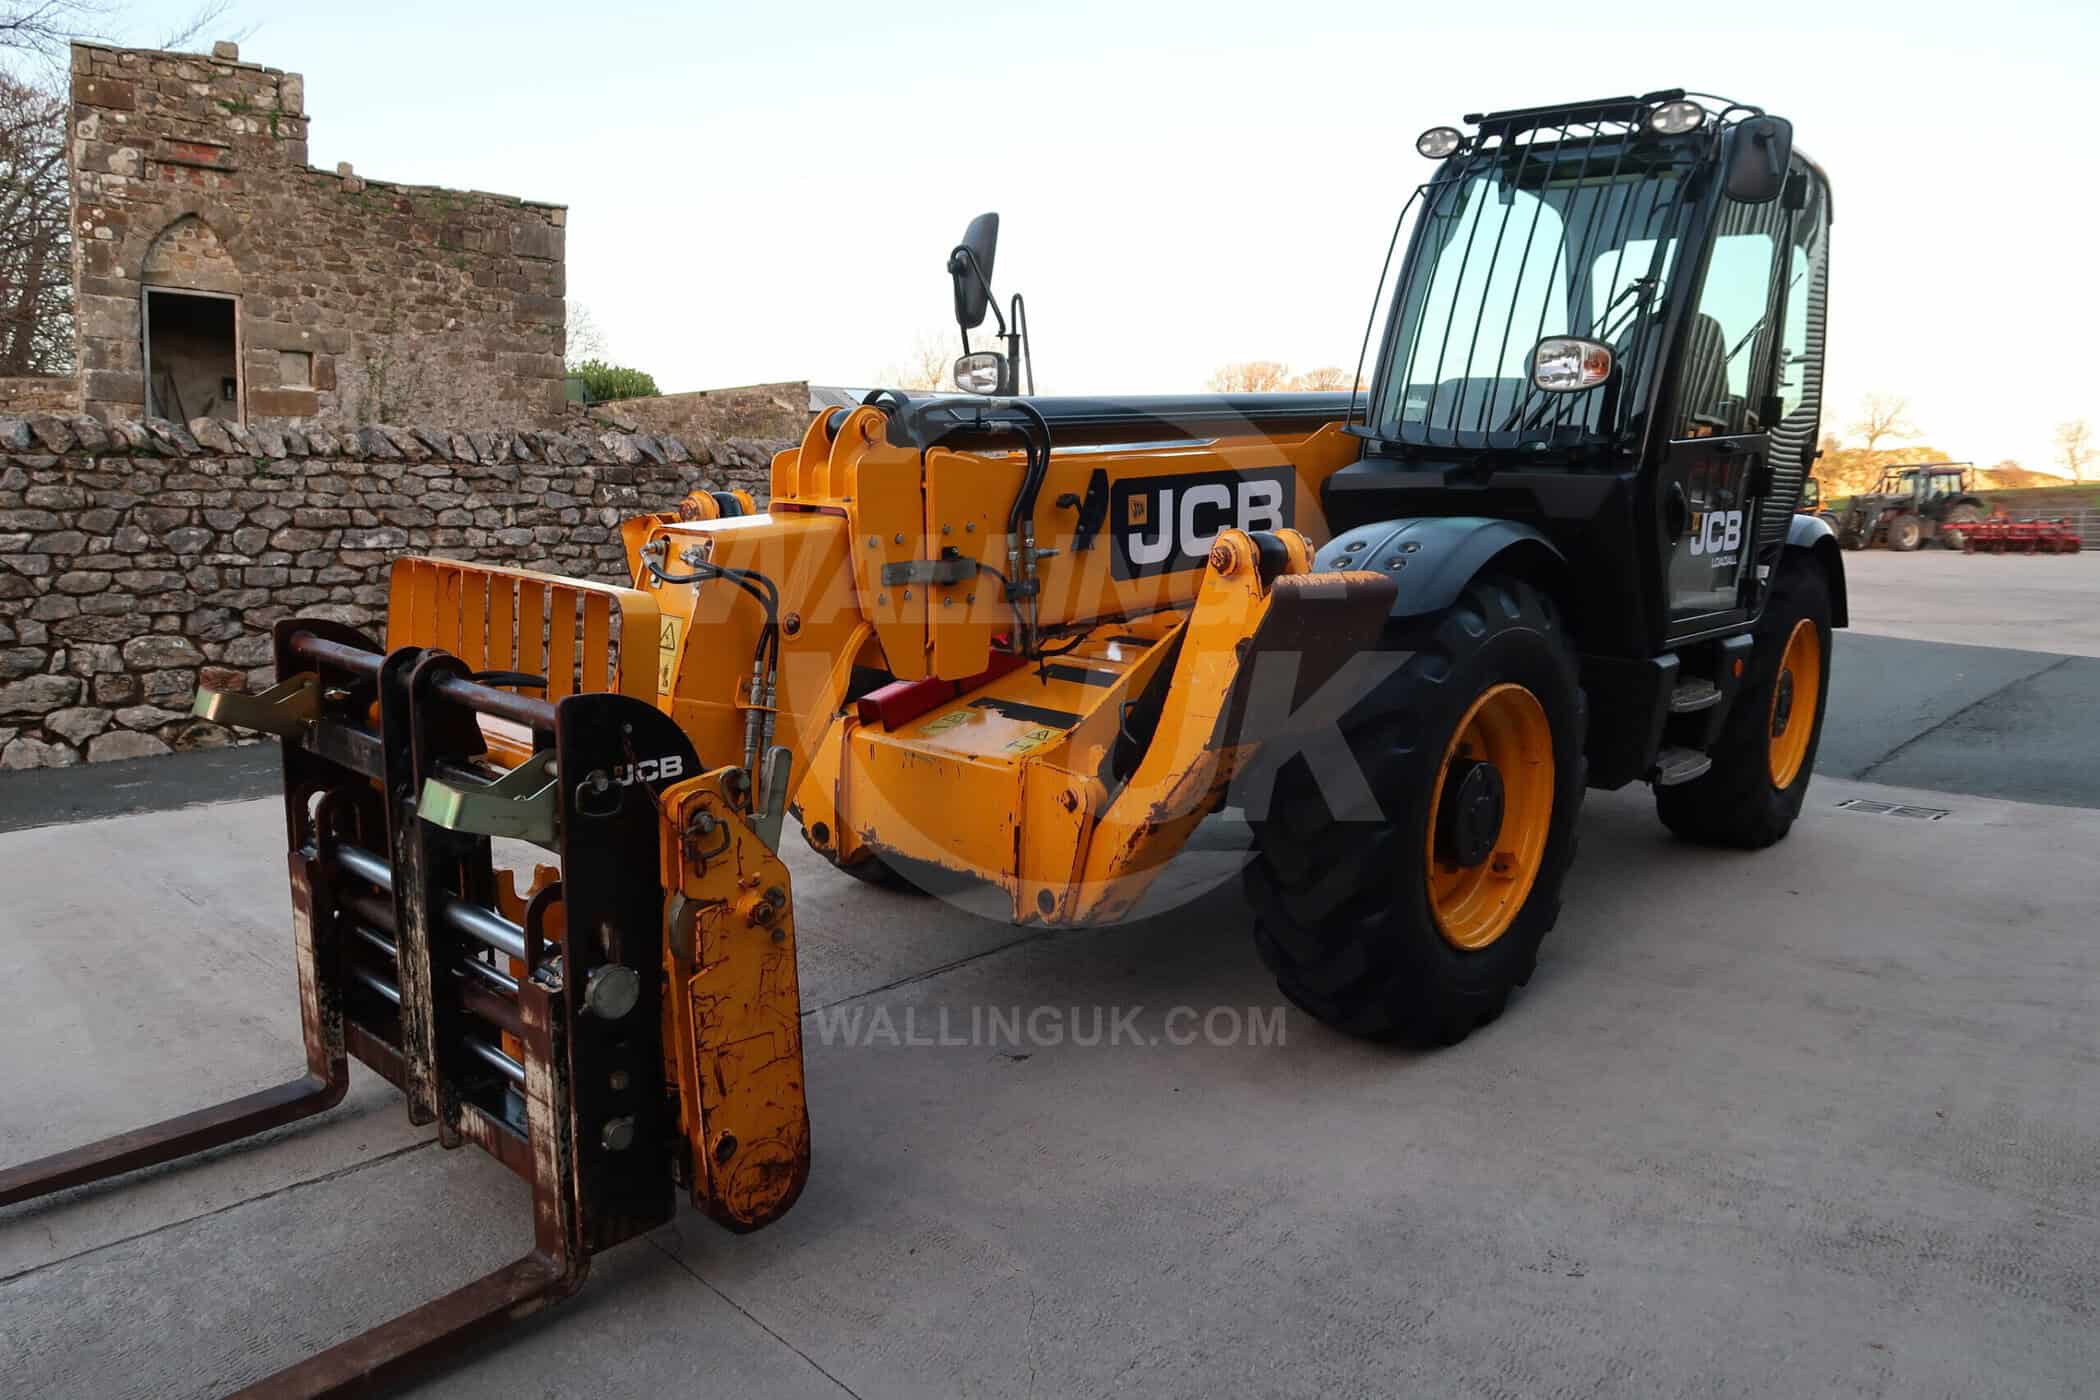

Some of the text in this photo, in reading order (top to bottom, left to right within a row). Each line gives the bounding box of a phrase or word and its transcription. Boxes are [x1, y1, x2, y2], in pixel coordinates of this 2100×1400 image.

[1128, 480, 1283, 564] JCB
[1690, 511, 1742, 555] JCB
[615, 755, 683, 787] JCB
